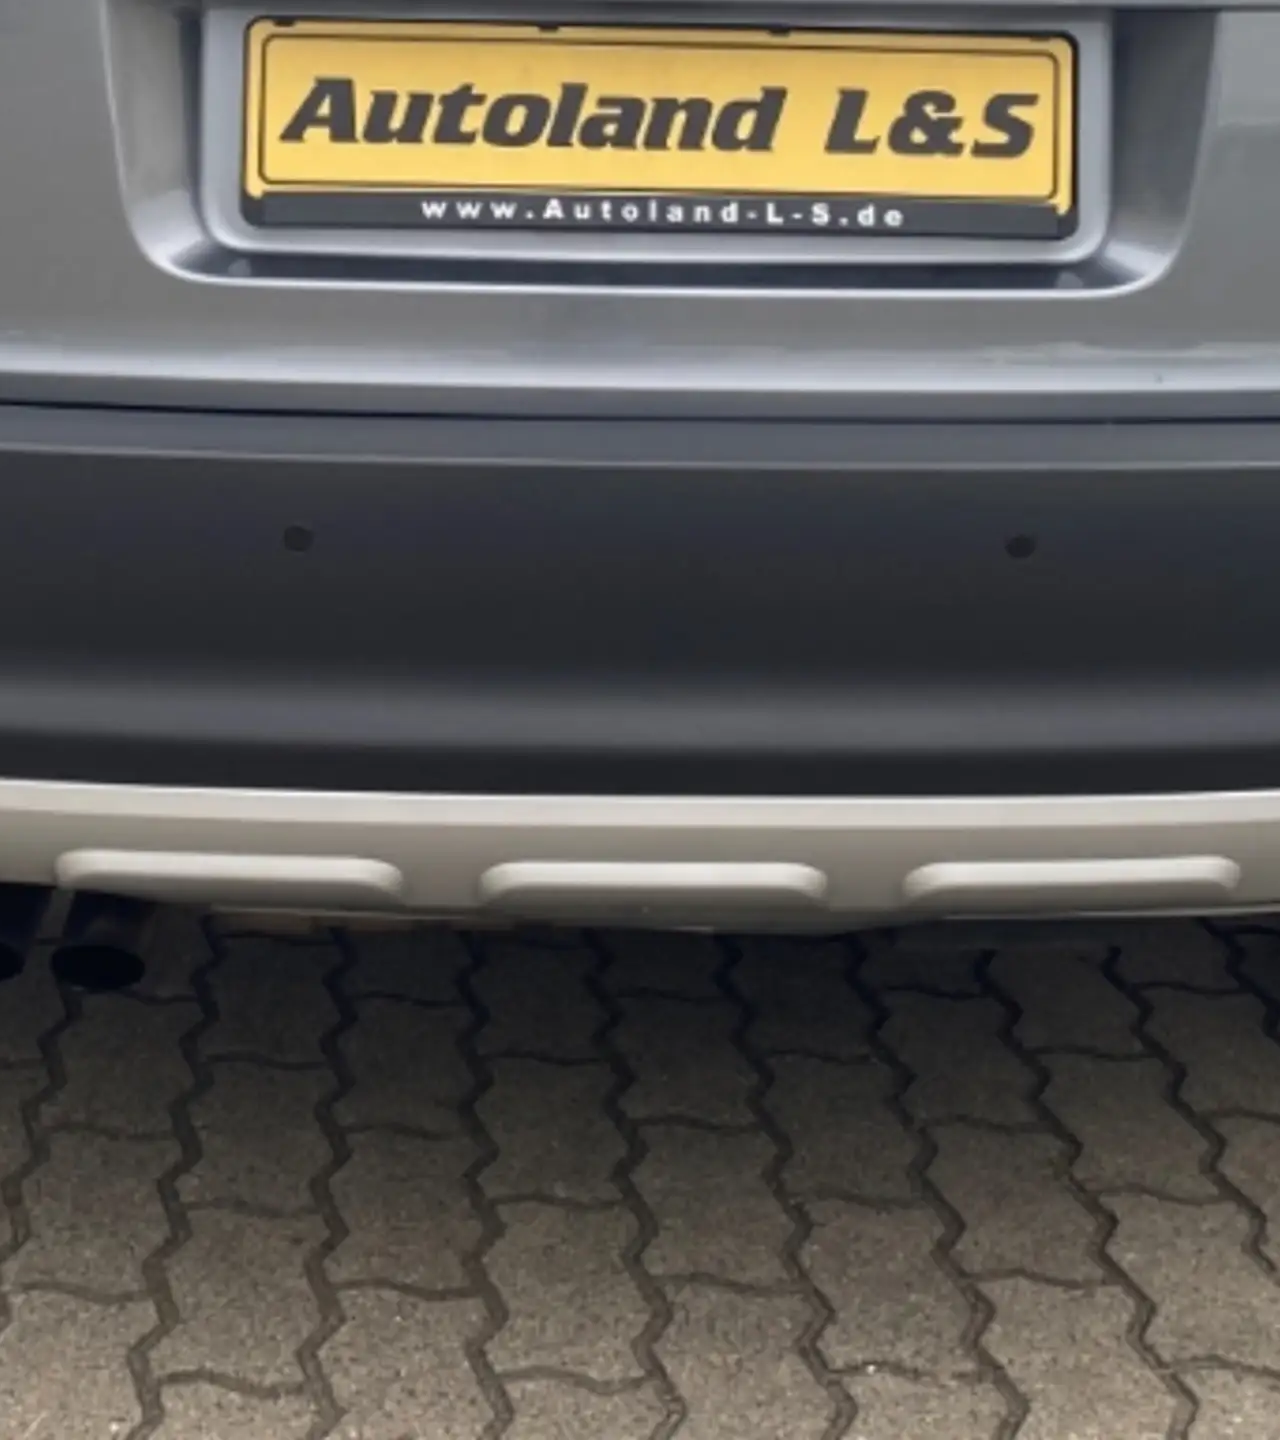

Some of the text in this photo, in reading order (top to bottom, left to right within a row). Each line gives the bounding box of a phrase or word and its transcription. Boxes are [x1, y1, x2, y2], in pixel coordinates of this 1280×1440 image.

[279, 77, 1040, 159] Autoland L&S
[421, 197, 905, 228] www.Autoland-L-S.de
